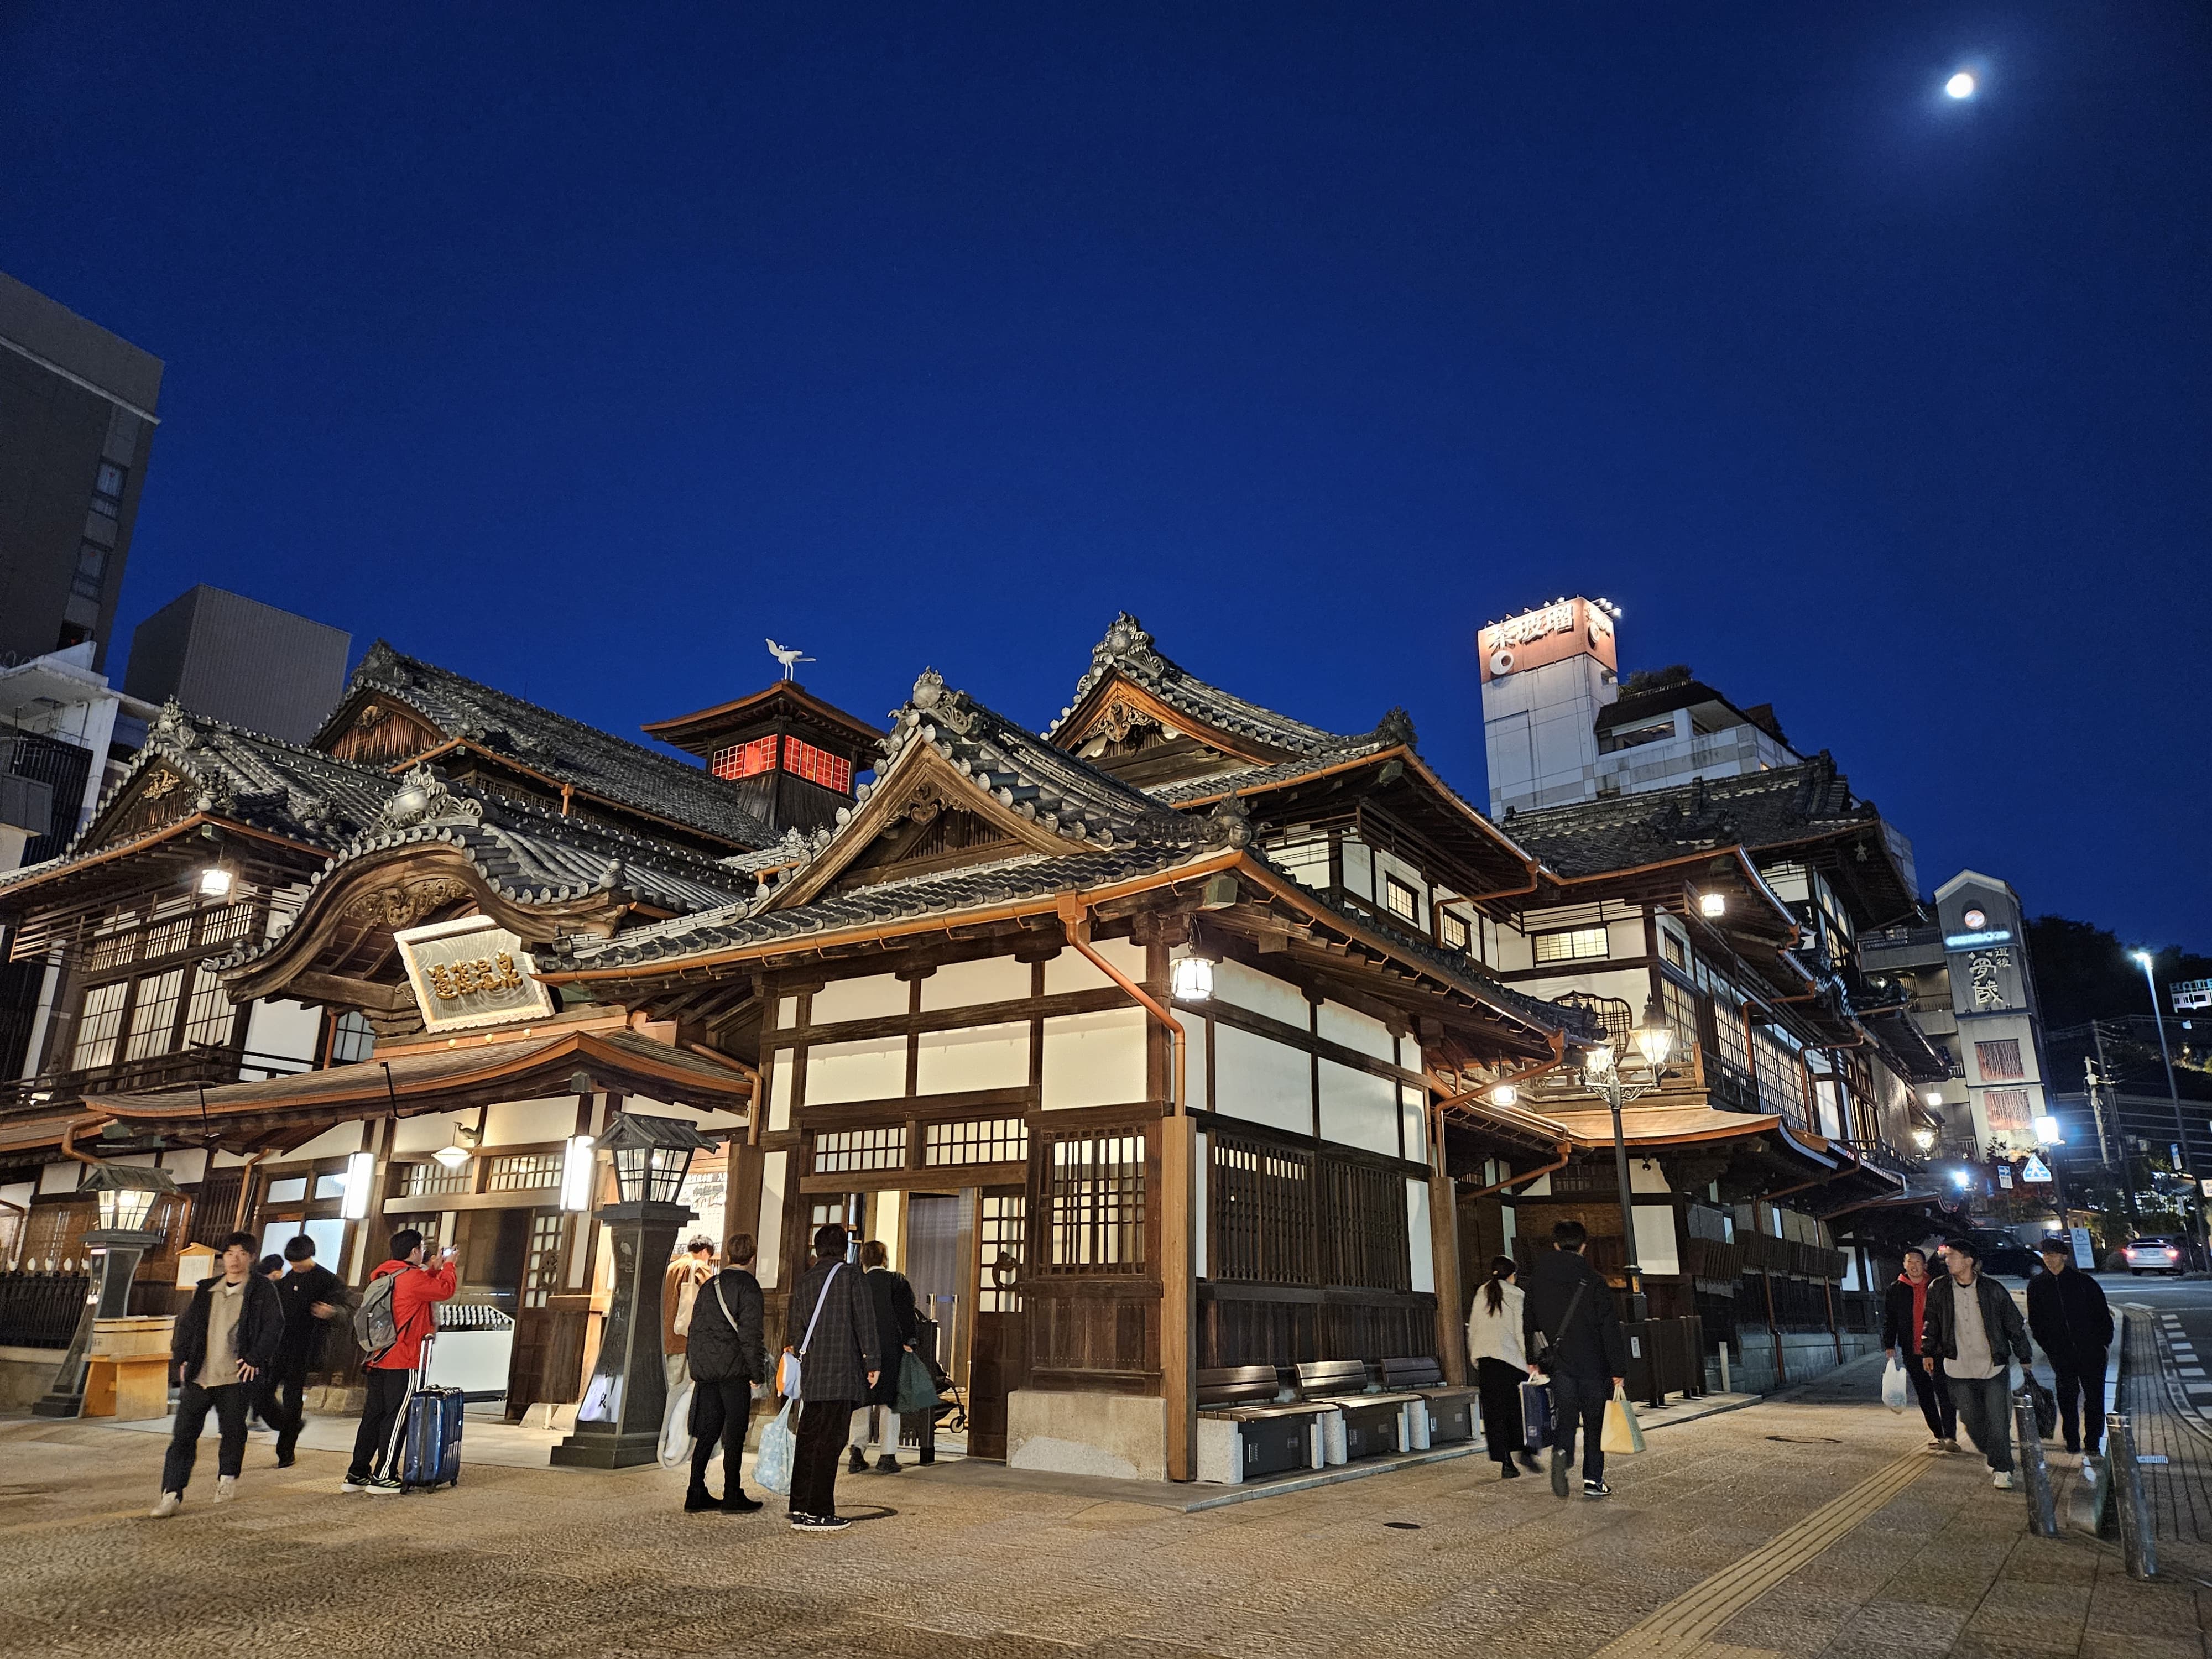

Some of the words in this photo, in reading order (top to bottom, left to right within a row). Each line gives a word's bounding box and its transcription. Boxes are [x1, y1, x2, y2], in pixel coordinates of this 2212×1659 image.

[1488, 603, 1573, 649] 茶玻瑠
[426, 949, 524, 1000] 道後温泉
[1995, 947, 2011, 968] 道後
